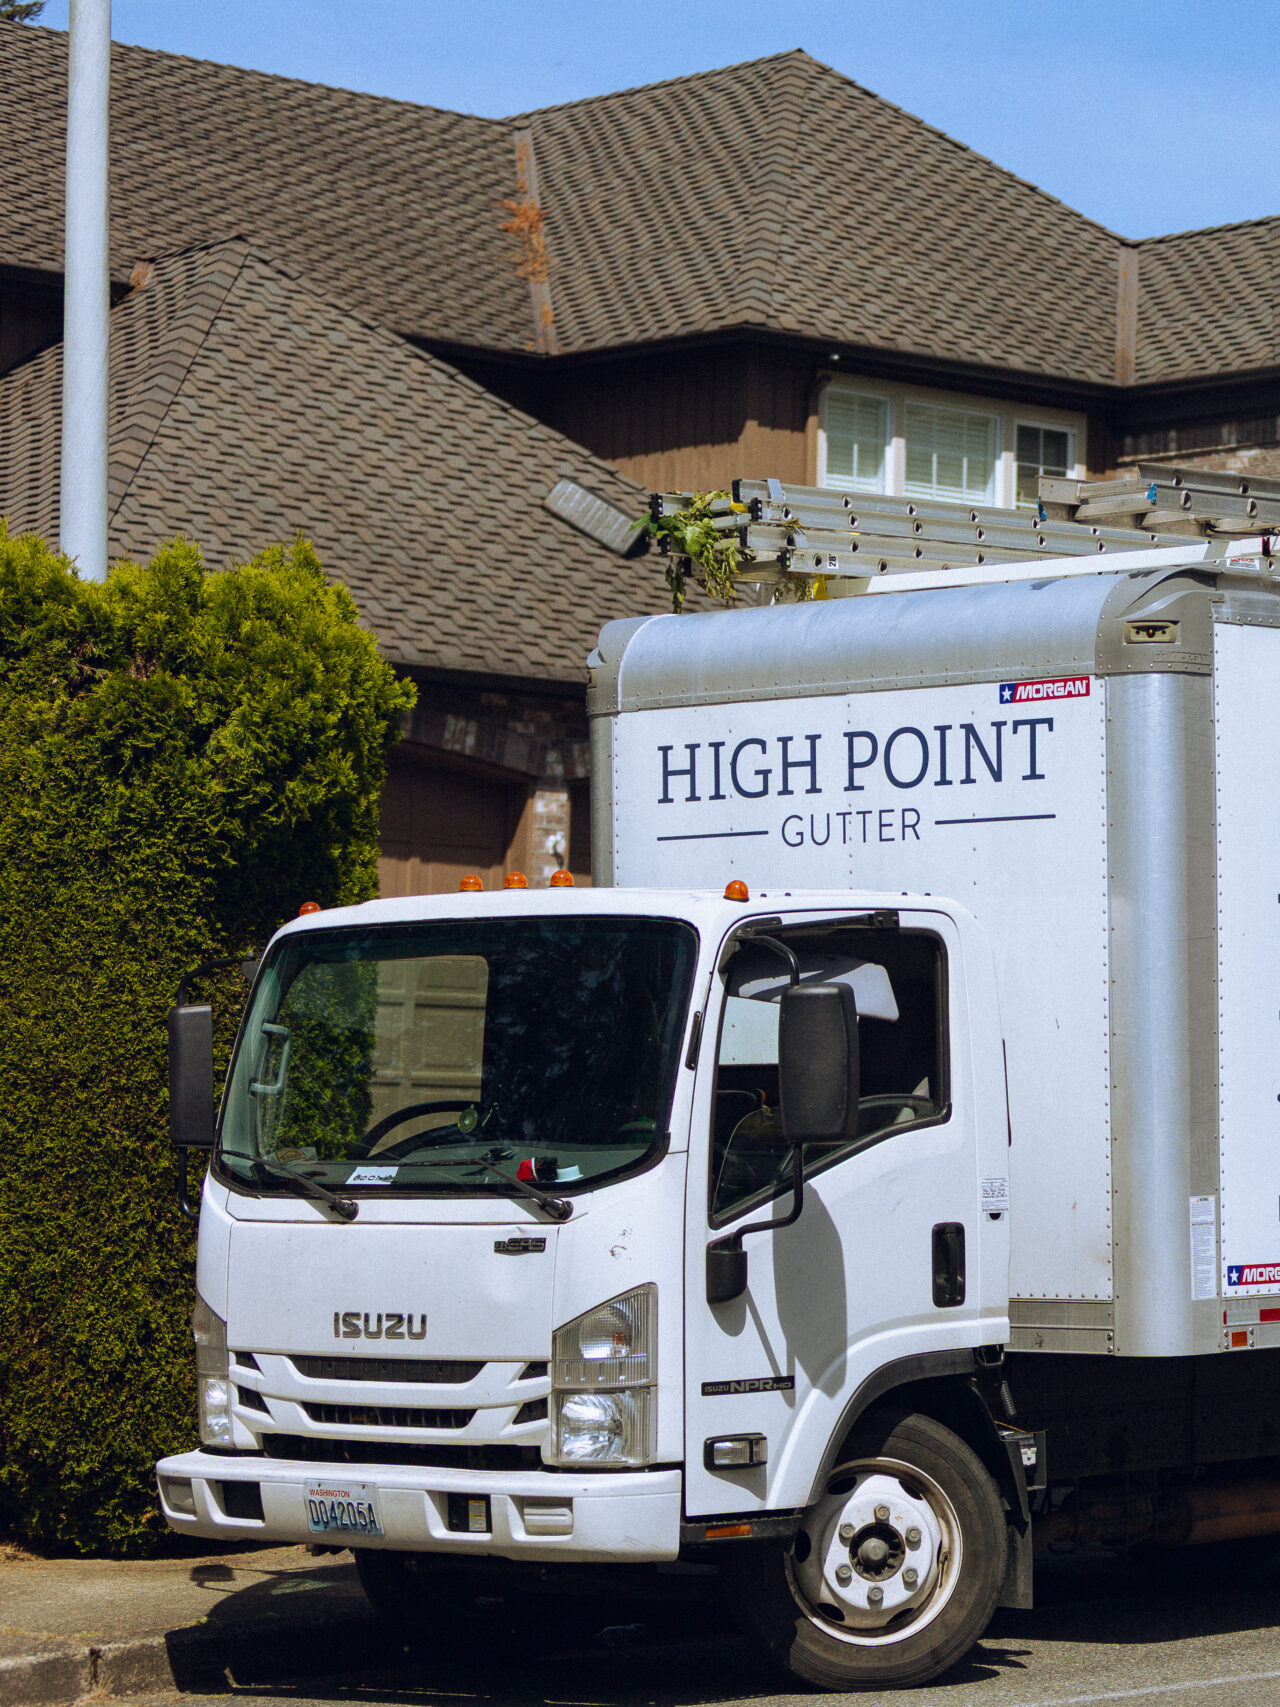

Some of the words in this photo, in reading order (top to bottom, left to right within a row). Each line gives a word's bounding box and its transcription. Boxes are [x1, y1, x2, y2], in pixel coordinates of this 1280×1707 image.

[1015, 680, 1087, 701] MORGAN
[657, 733, 823, 804] HIGH
[843, 717, 1054, 792] POINT
[781, 808, 922, 848] GUTTER
[333, 1311, 428, 1340] ISUZU
[704, 1385, 729, 1393] ISUZU
[309, 1488, 350, 1499] WASHINGTON
